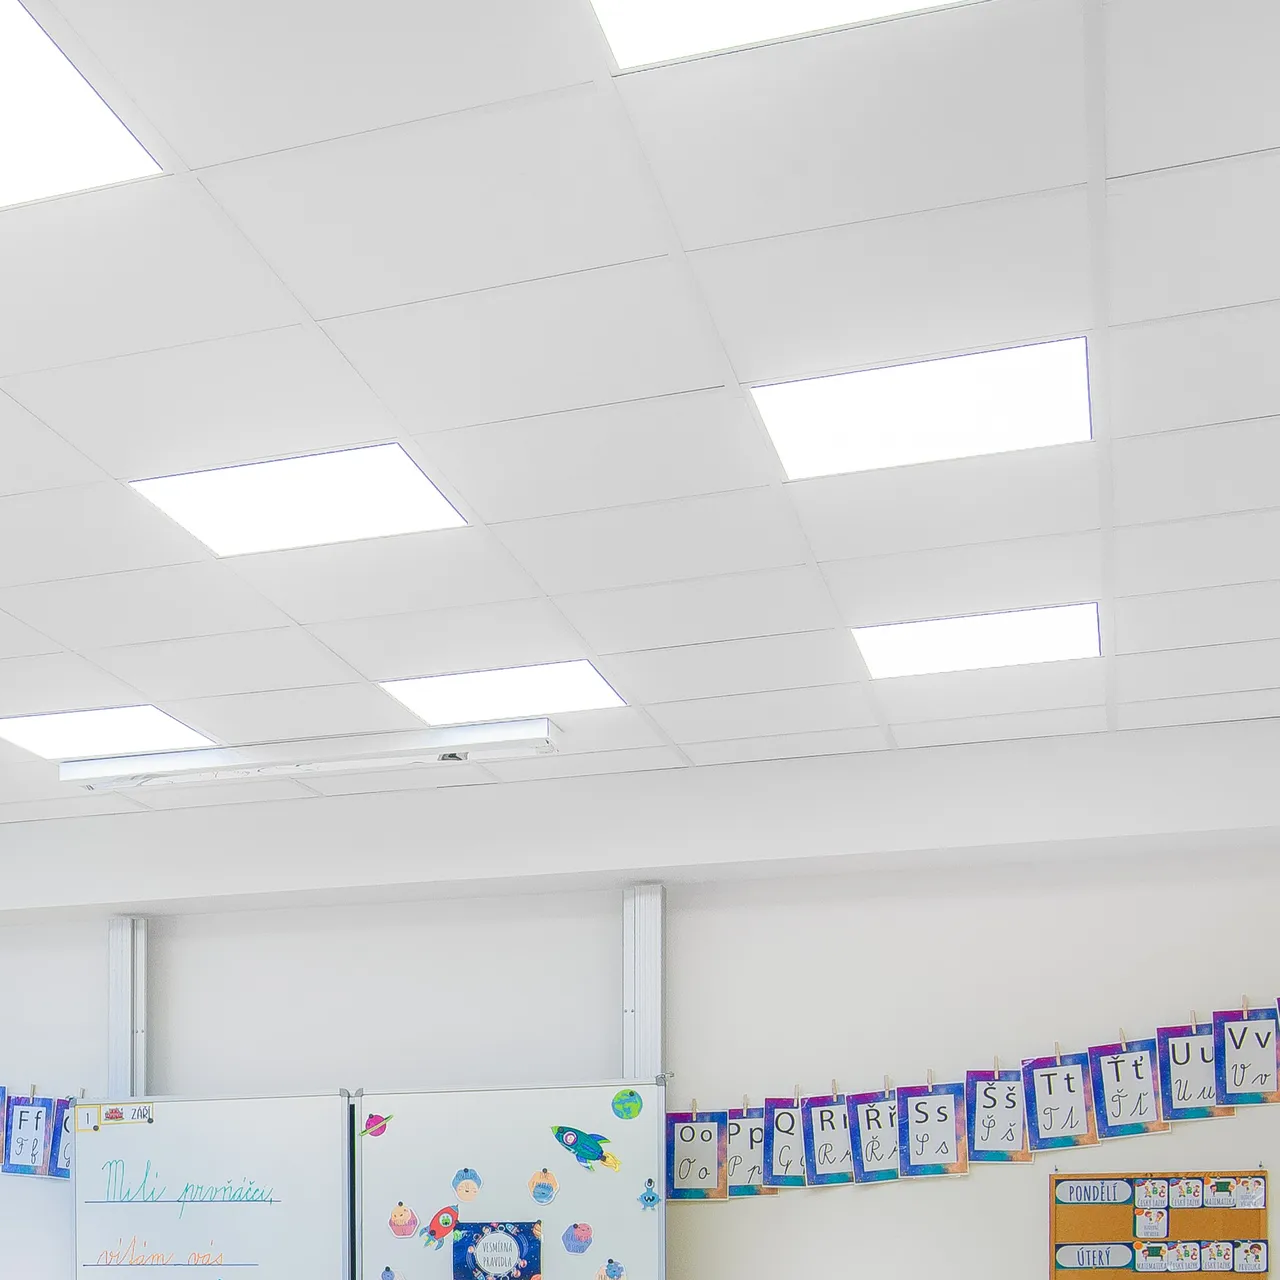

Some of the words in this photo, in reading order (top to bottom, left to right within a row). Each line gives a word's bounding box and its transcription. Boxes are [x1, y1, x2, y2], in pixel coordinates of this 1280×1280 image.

[1069, 1181, 1118, 1201] PONDĚLÍ
[97, 1235, 174, 1265] vítám
[187, 1239, 224, 1265] vás
[482, 1240, 513, 1253] VESMÍRNÁ
[1077, 1246, 1111, 1266] ÚTERÝ
[483, 1256, 512, 1267] PRAVIDLA
